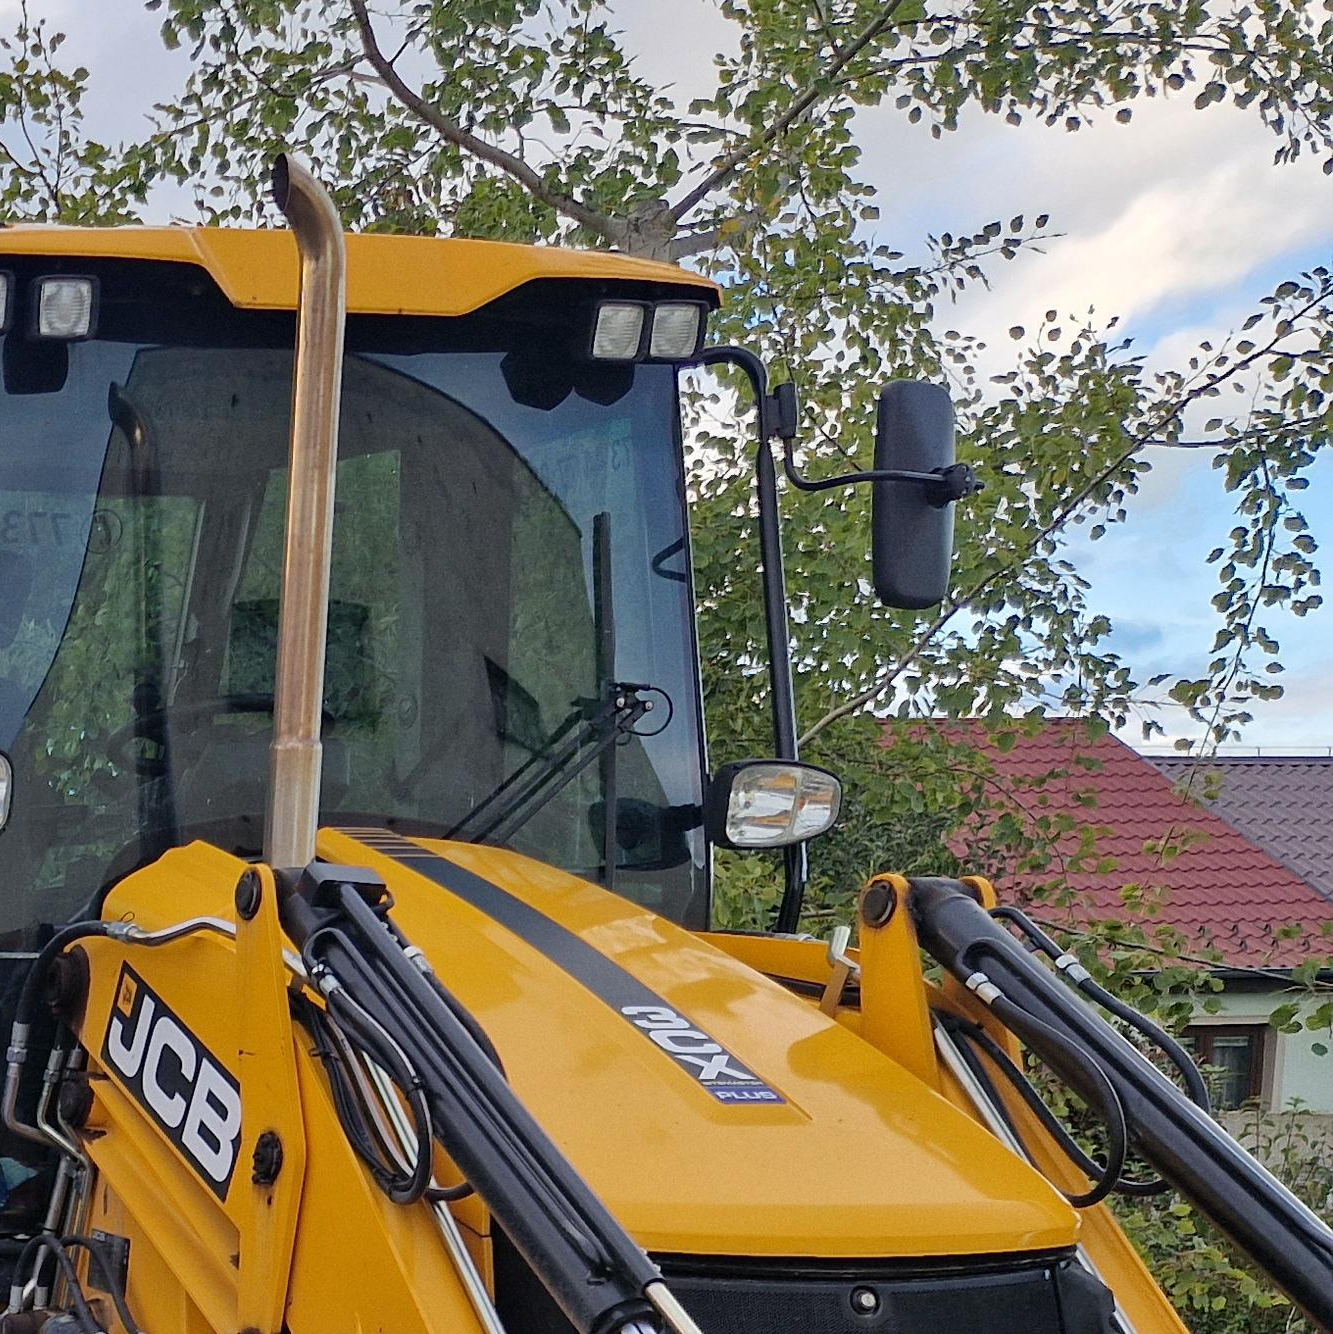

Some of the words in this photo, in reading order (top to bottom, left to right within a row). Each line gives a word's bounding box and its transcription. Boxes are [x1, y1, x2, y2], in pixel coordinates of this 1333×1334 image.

[621, 1006, 757, 1080] 3CX
[108, 994, 242, 1183] JCB
[715, 1091, 778, 1100] PLUS
